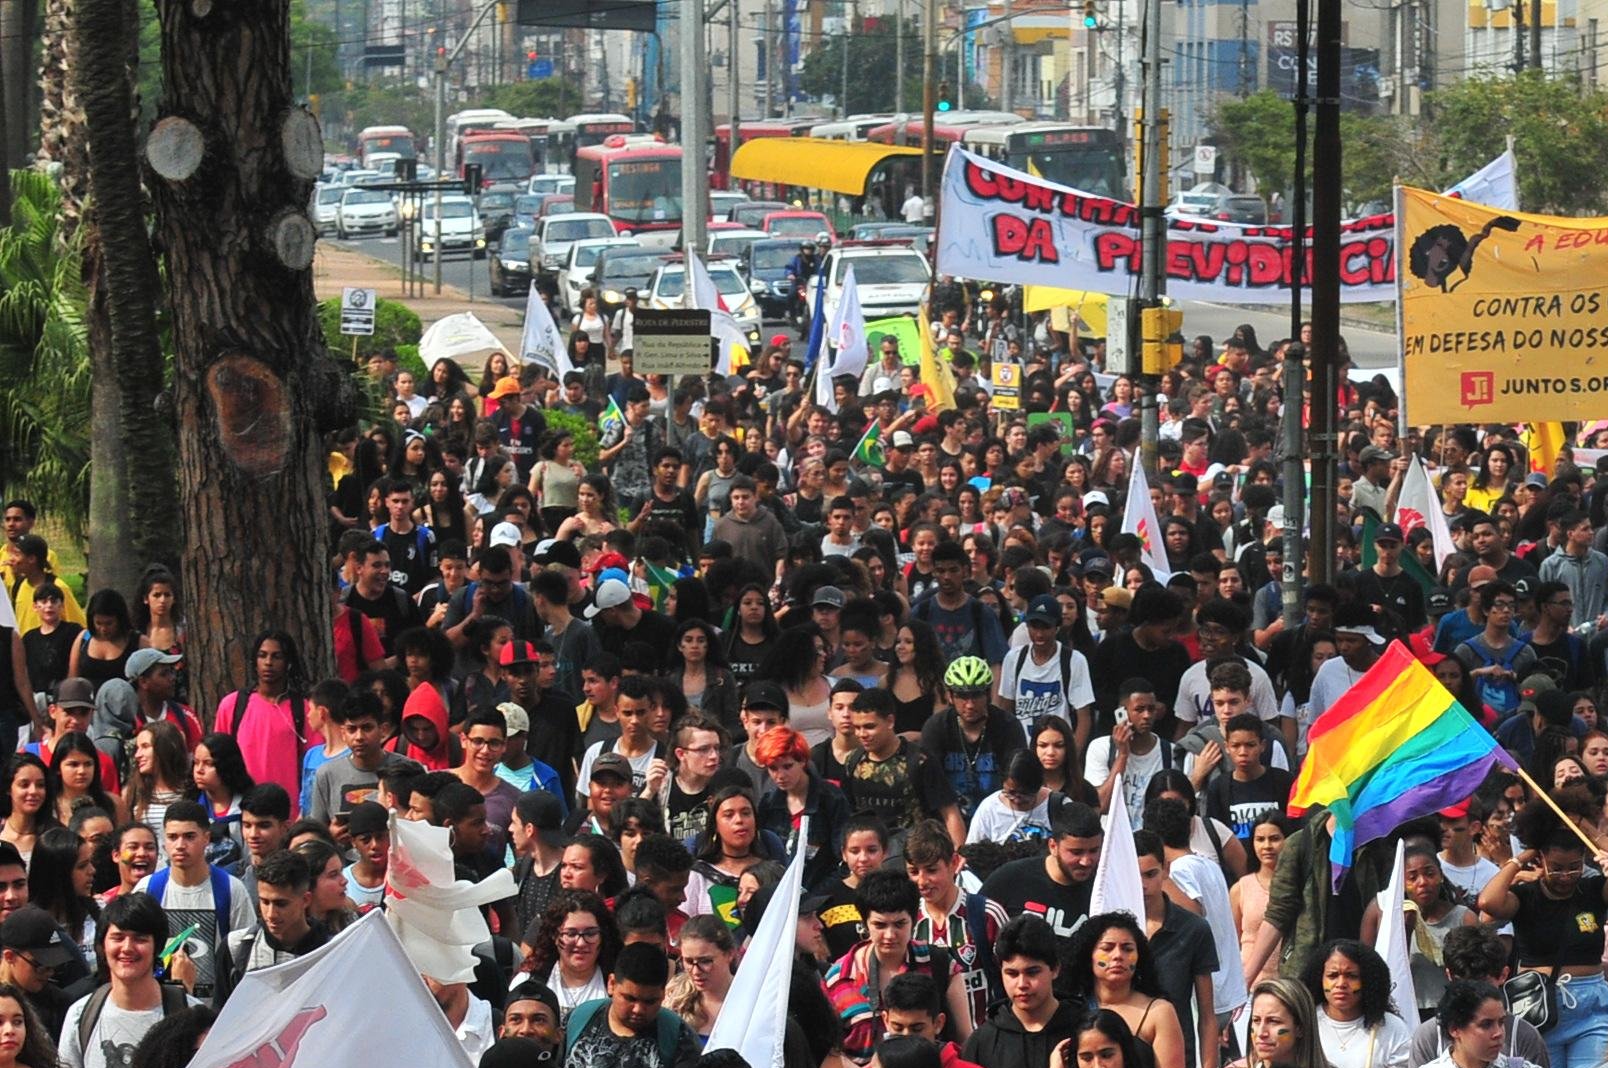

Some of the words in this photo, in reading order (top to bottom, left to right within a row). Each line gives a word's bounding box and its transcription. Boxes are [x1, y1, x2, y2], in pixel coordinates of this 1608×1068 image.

[994, 213, 1060, 264] DA
[1474, 295, 1561, 318] CONTRA
[1571, 292, 1599, 314] OS
[1405, 335, 1424, 356] EM
[1430, 330, 1506, 353] DEFESA
[1513, 328, 1543, 350] DO
